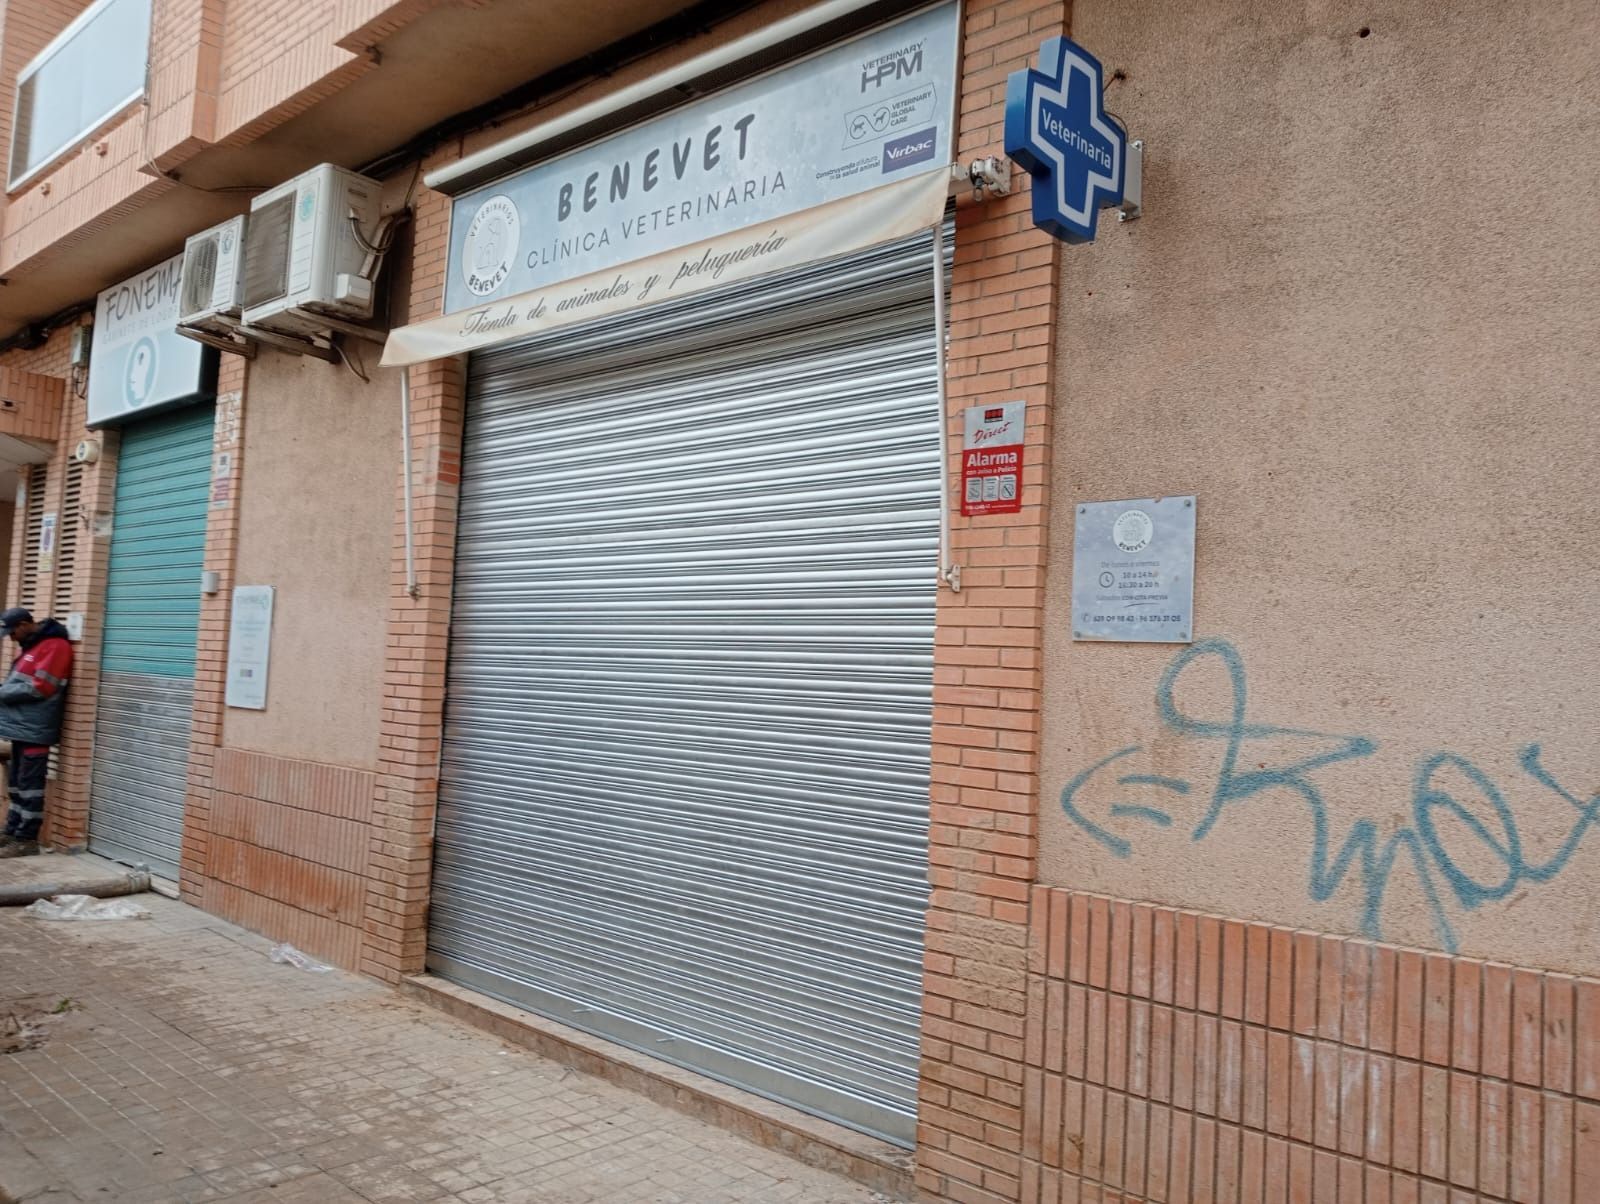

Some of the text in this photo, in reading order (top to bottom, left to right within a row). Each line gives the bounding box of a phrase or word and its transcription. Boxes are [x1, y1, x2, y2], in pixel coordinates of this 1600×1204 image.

[862, 42, 924, 71] VETERINARY
[861, 51, 923, 93] HPM
[891, 105, 917, 119] GLOBAL
[892, 90, 933, 110] VETERINARY
[890, 115, 909, 127] CARE
[886, 139, 934, 160] Virbac
[1042, 107, 1112, 169] Veterinaria
[557, 113, 757, 222] BENEVET
[527, 170, 787, 269] CLÍNICA VETERINARIA
[458, 229, 789, 337] Tienda de animales y peluquería
[468, 260, 509, 292] BENEVET
[967, 451, 1018, 467] Alarma
